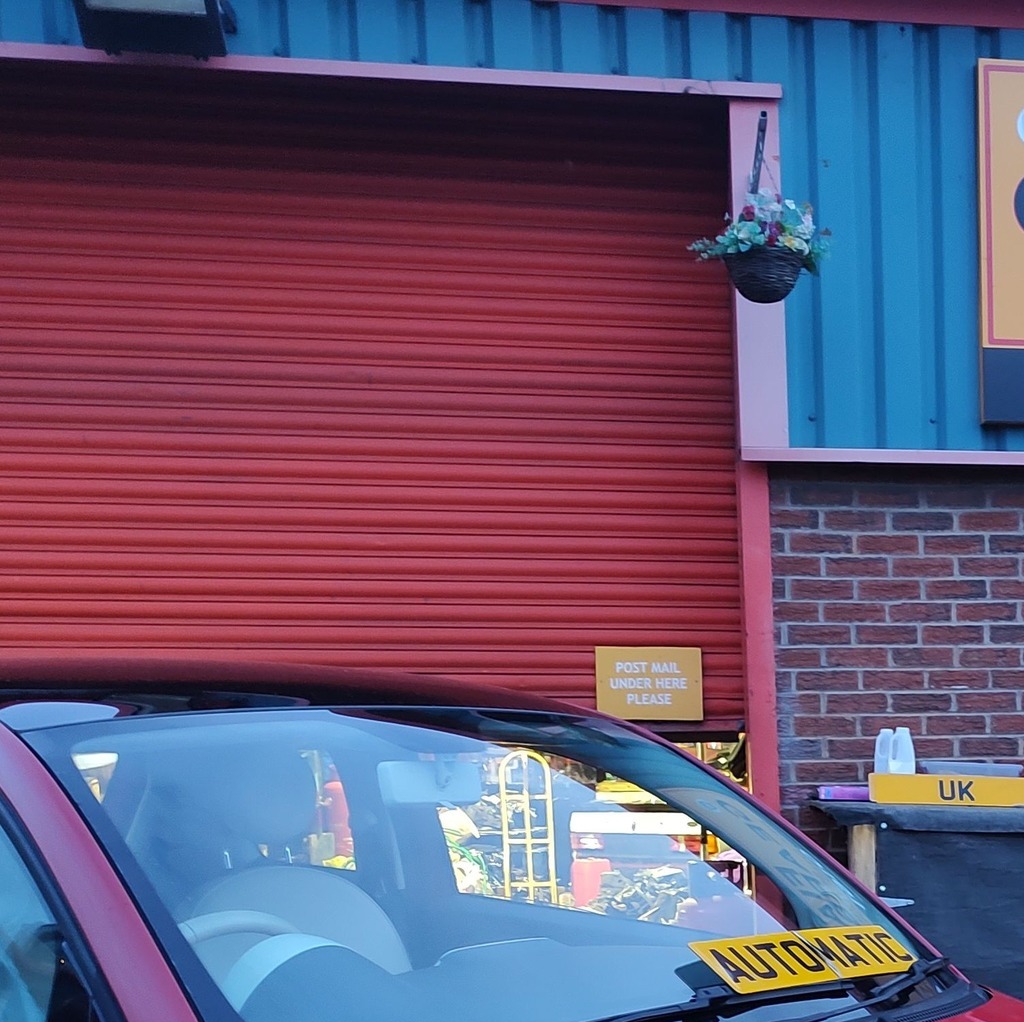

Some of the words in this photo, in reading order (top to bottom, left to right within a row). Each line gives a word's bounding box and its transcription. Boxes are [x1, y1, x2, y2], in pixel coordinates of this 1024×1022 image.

[615, 661, 648, 674] POST
[651, 661, 682, 674] MAIL
[609, 677, 653, 690] UNDER
[655, 677, 688, 690] HERE
[626, 692, 673, 705] PLEASE
[938, 779, 976, 802] UK
[709, 932, 912, 984] AUTOMATIC
